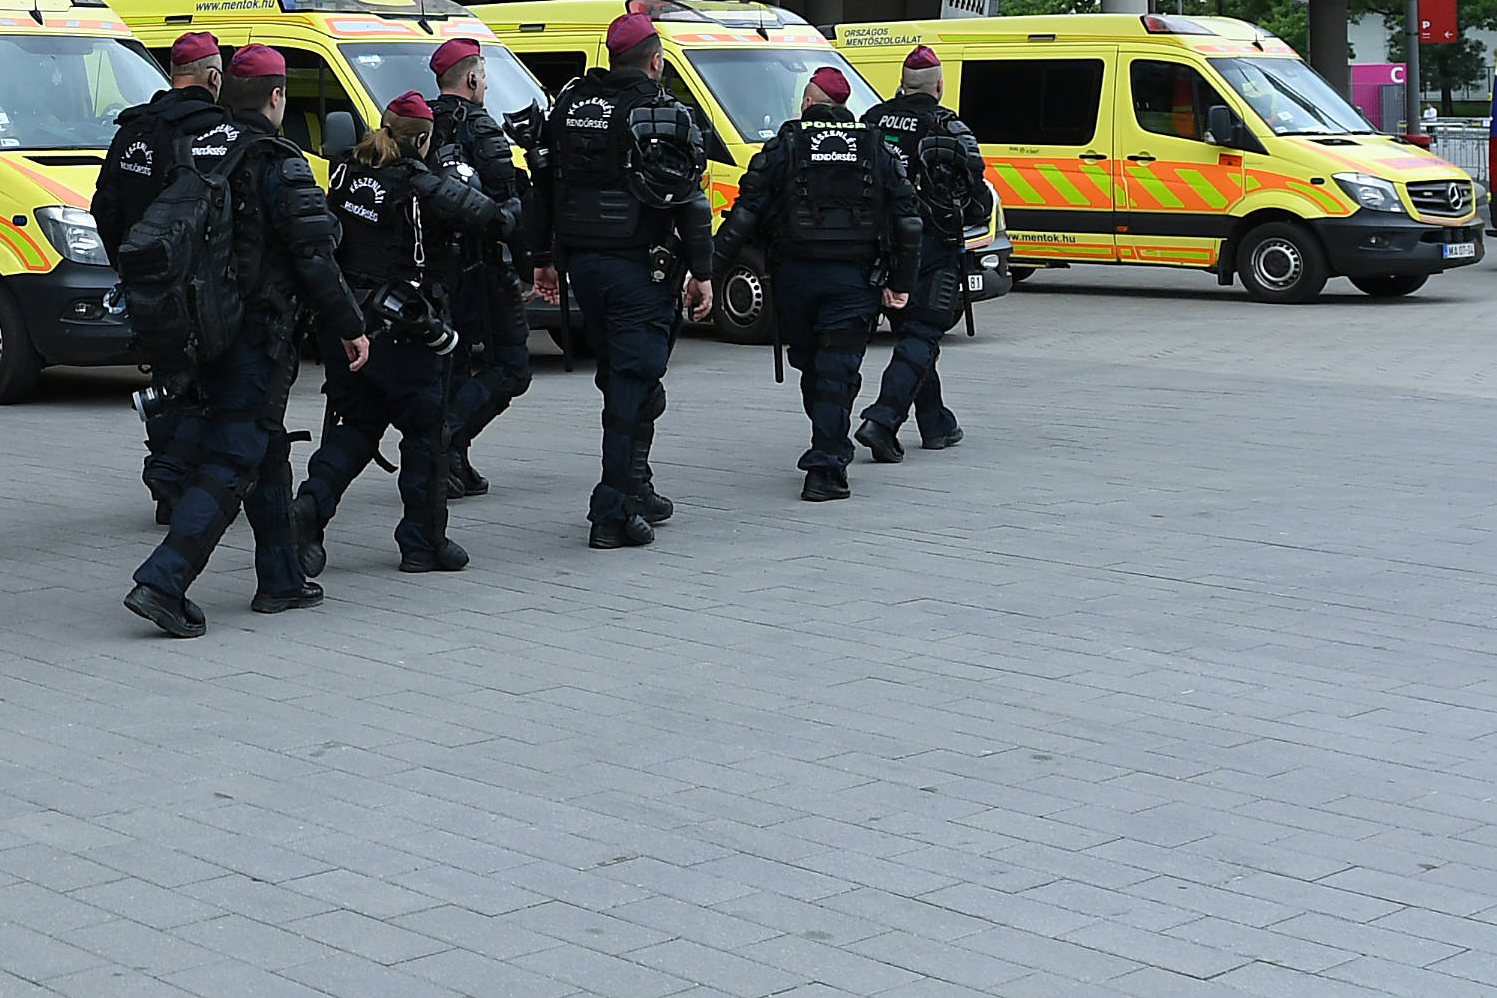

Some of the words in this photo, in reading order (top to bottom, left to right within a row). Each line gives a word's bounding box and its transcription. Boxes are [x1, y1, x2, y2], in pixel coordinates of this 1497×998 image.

[844, 28, 889, 38] ORSZÁGOS
[879, 115, 919, 132] POLICE
[811, 130, 857, 152] KÉSZENLÉTI
